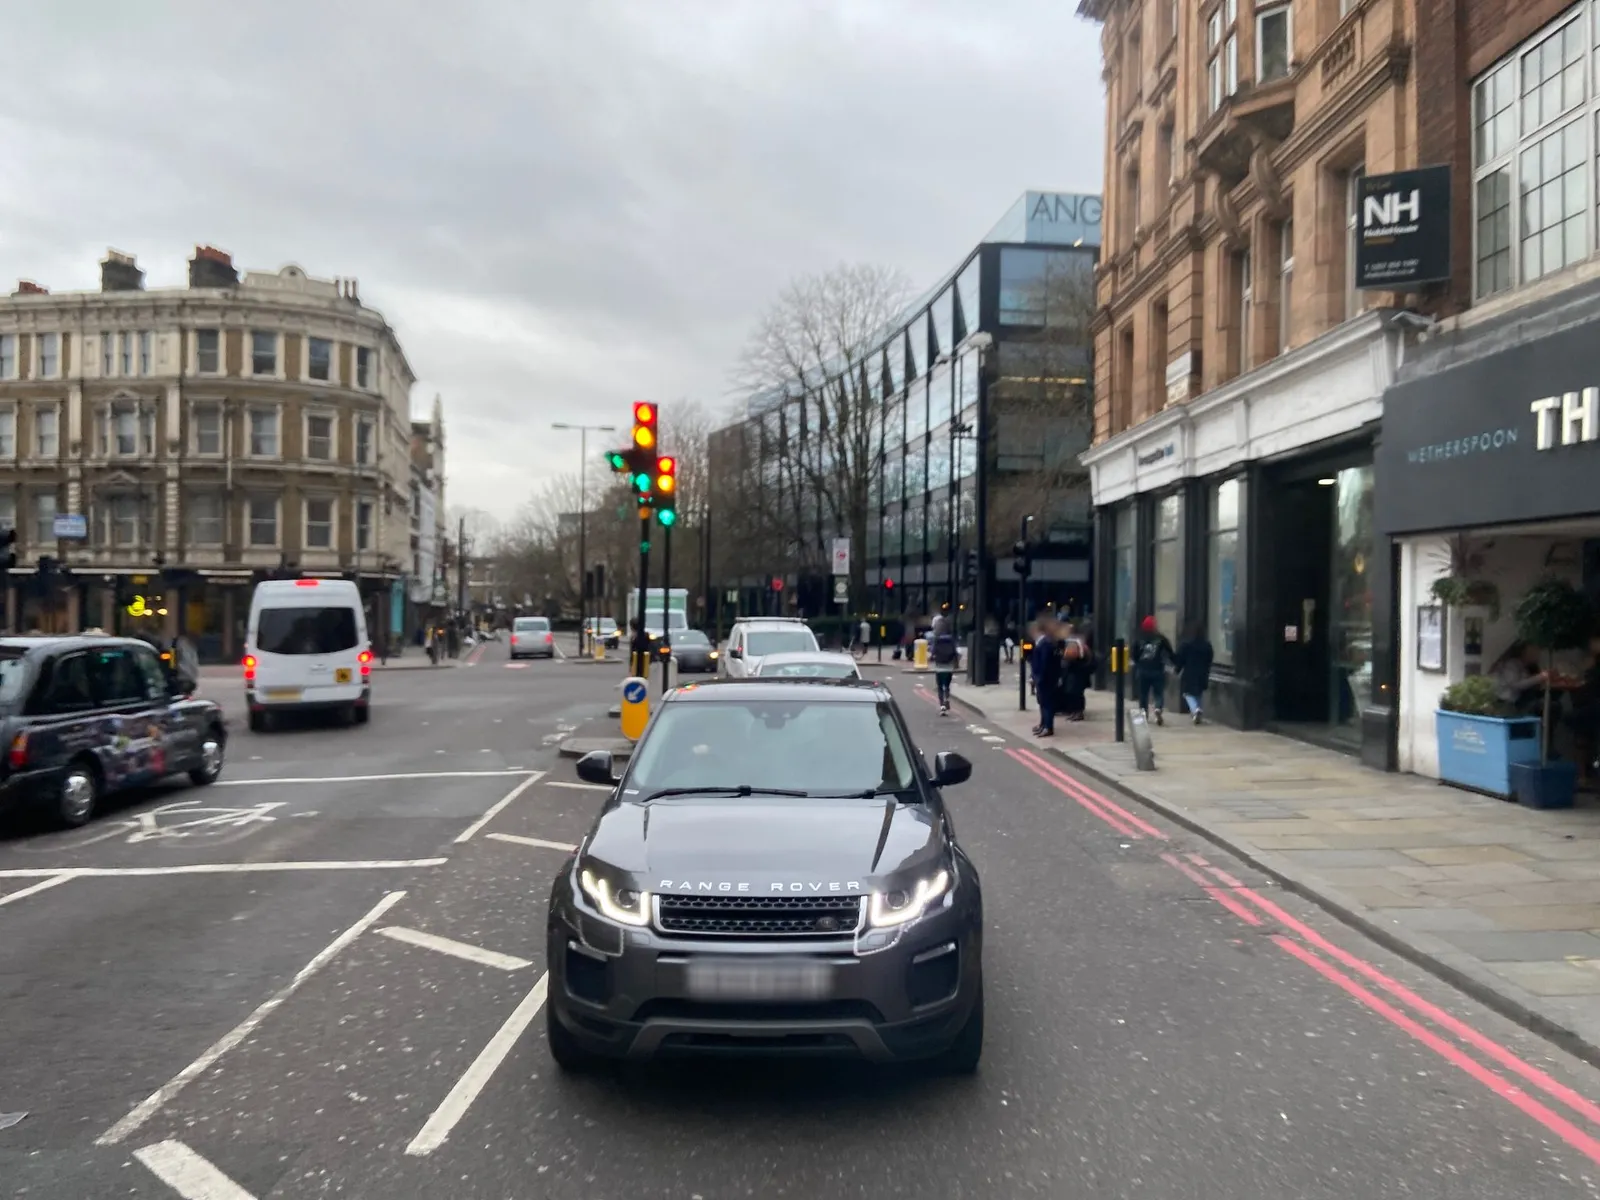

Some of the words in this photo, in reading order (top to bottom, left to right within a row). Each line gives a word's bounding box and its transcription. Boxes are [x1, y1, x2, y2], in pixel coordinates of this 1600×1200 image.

[1030, 192, 1103, 226] ANG
[1363, 188, 1420, 228] NH
[1530, 386, 1600, 451] TH
[1407, 428, 1519, 463] WETHERSPOON
[659, 879, 750, 892] RANGE
[770, 880, 861, 892] ROVER
